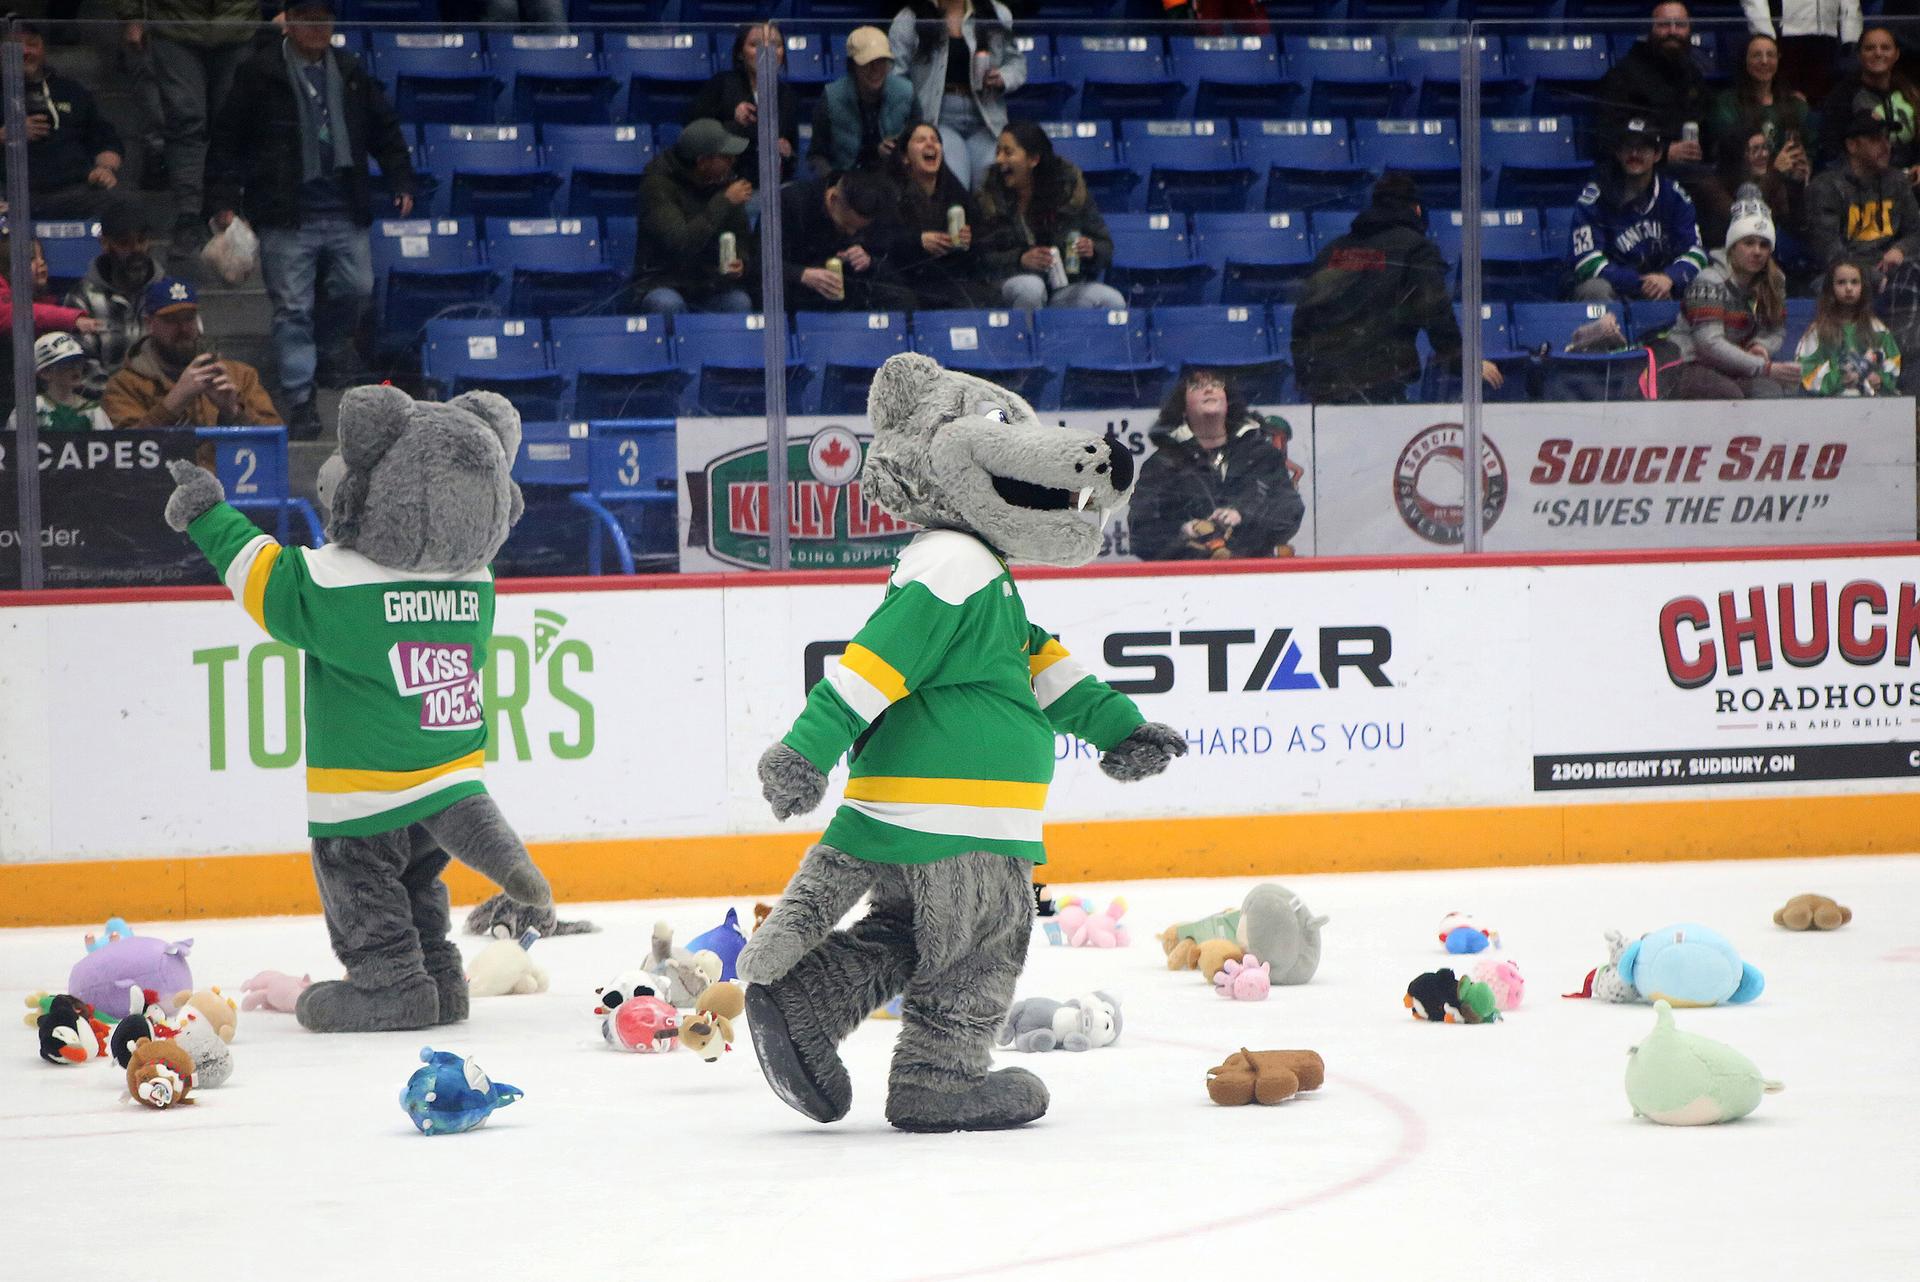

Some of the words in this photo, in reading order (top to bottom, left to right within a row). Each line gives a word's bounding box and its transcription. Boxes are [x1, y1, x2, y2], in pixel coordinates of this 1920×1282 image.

[1573, 225, 1594, 256] 53
[234, 447, 258, 494] 2
[618, 439, 640, 487] 3
[1529, 438, 1712, 485] SOUCIE
[1717, 435, 1848, 482] SALO
[847, 481, 924, 538] LA
[1664, 495, 1725, 525] THE
[0, 525, 86, 549] oder.
[757, 546, 835, 564] BLDING
[842, 543, 905, 563] SUPPLI
[383, 590, 480, 623] GROWLER
[1102, 625, 1394, 694] STAR
[1185, 726, 1273, 756] HARD
[1288, 724, 1326, 752] AS
[1341, 721, 1405, 751] YOU
[1766, 721, 1797, 730] BAR
[1808, 718, 1841, 730] AND
[1852, 717, 1902, 728] GRILL
[1551, 763, 1595, 782] 2309
[1595, 759, 1661, 780] REGENT
[1661, 759, 1686, 778] ST,
[1769, 754, 1796, 773] ON
